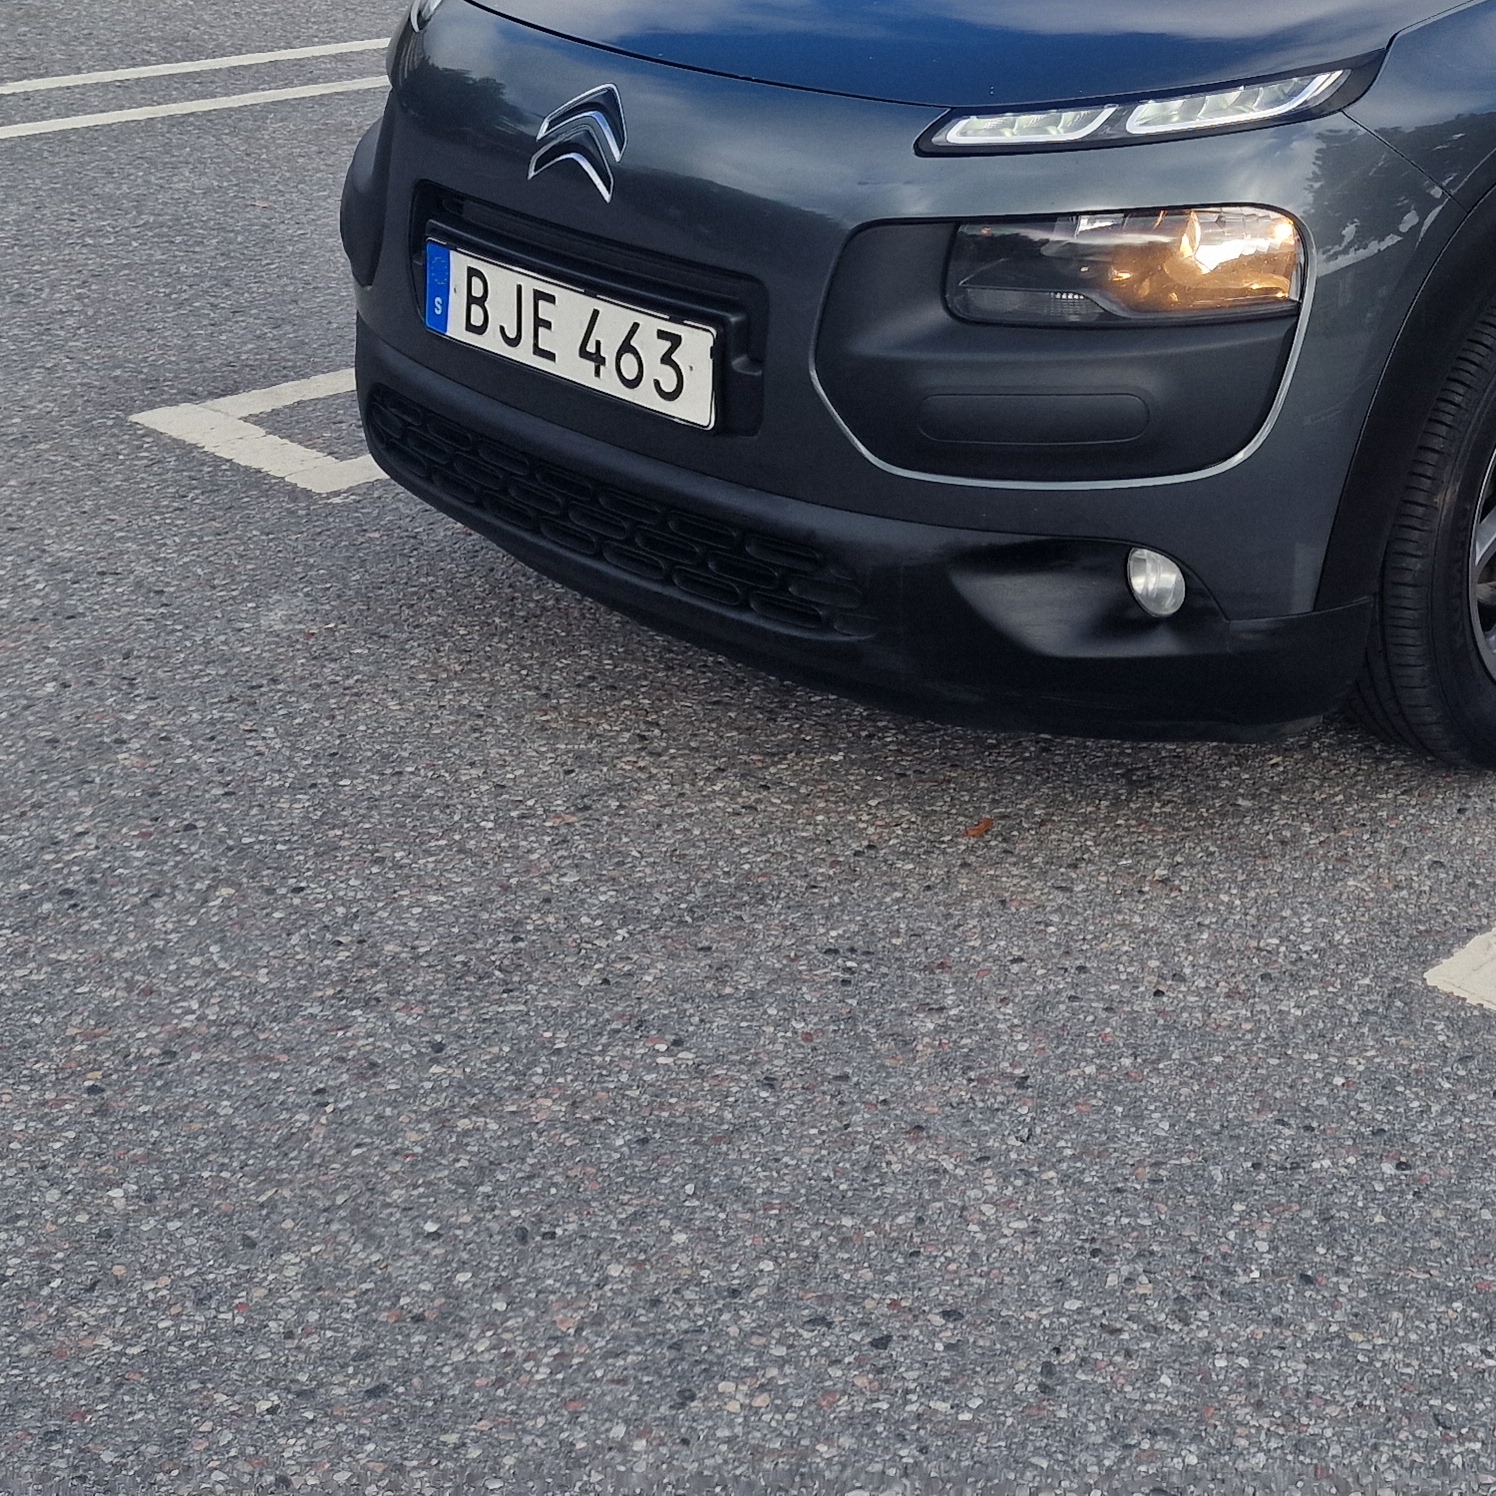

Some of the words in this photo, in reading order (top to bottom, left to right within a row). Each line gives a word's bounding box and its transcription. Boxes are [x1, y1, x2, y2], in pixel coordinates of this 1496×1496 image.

[433, 297, 443, 315] S
[464, 265, 557, 364] BJE
[577, 307, 684, 402] 463
